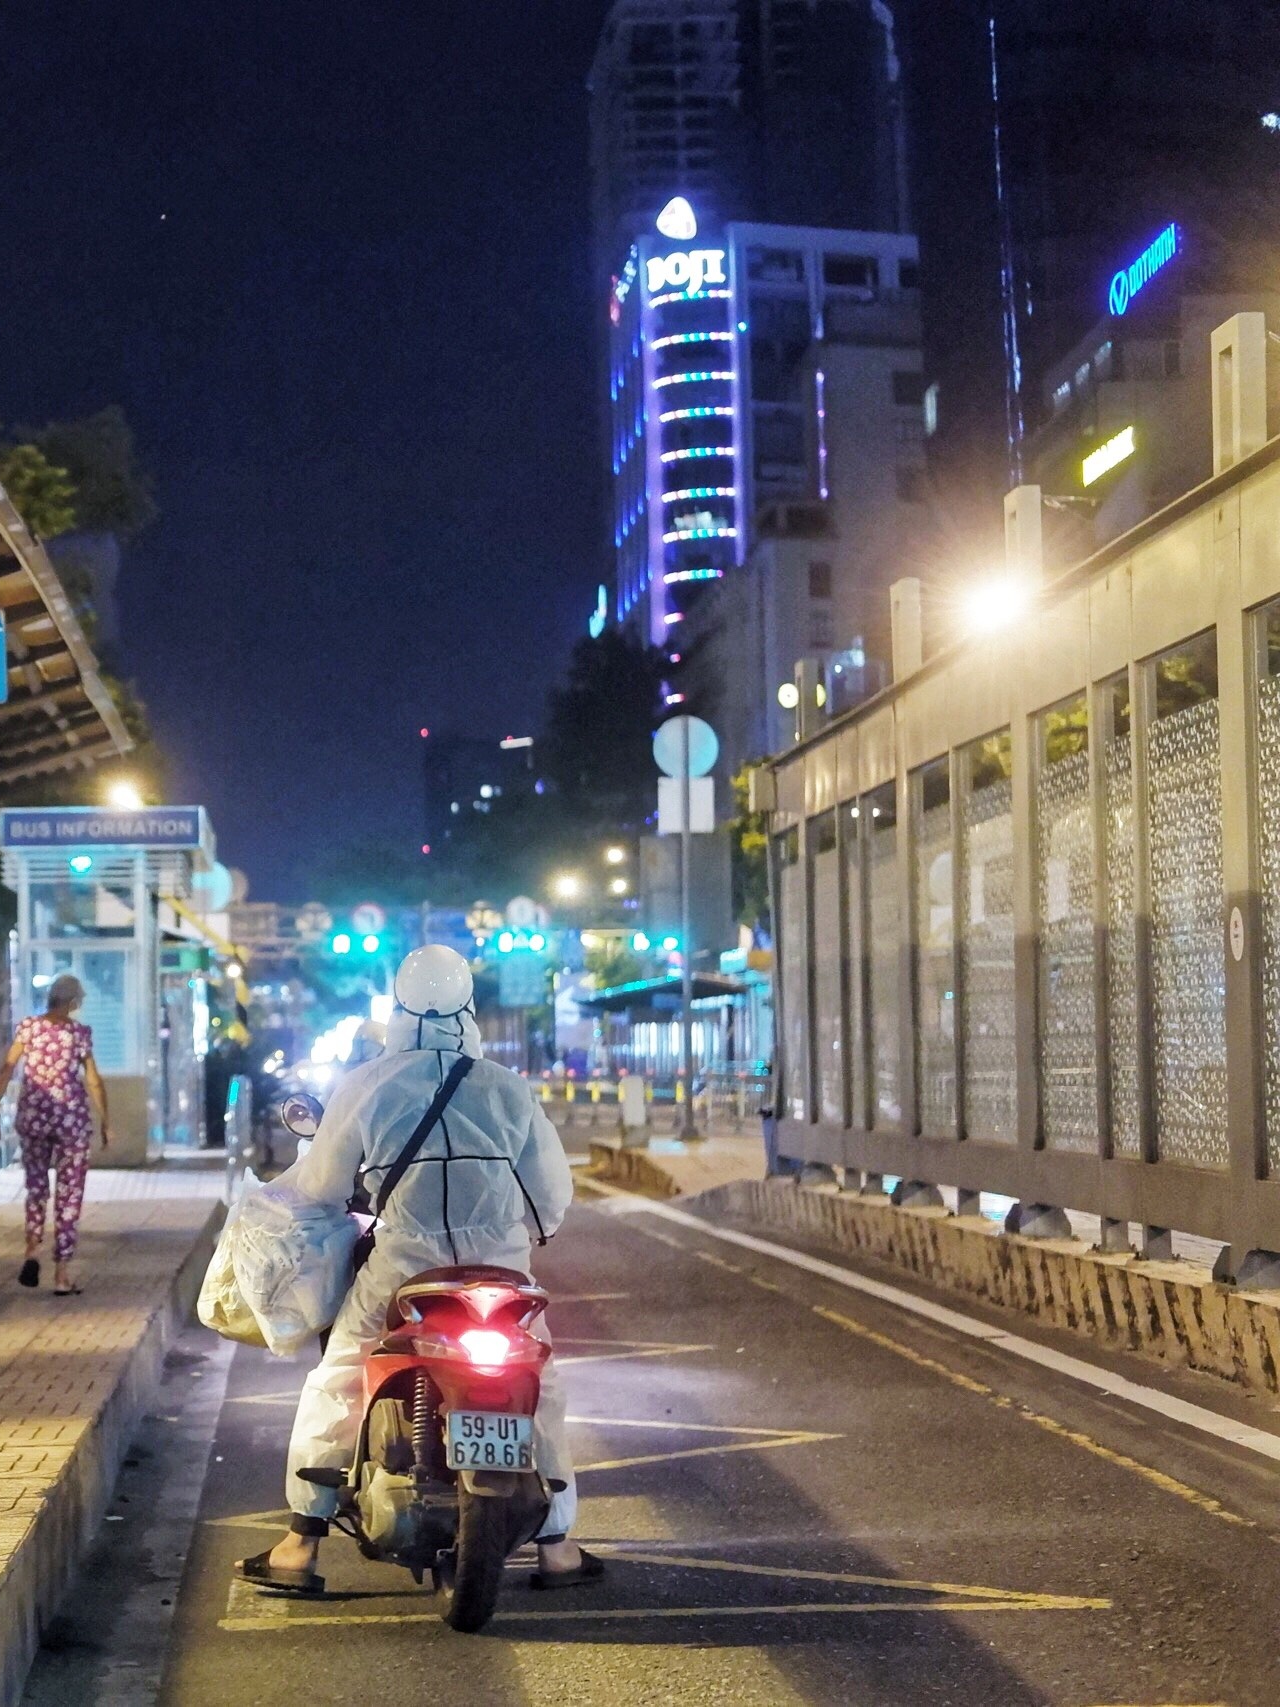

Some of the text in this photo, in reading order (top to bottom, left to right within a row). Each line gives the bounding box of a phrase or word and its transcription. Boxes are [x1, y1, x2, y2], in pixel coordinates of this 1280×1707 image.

[9, 818, 193, 839] BUS INFORMATION
[461, 1415, 518, 1441] 59-U1
